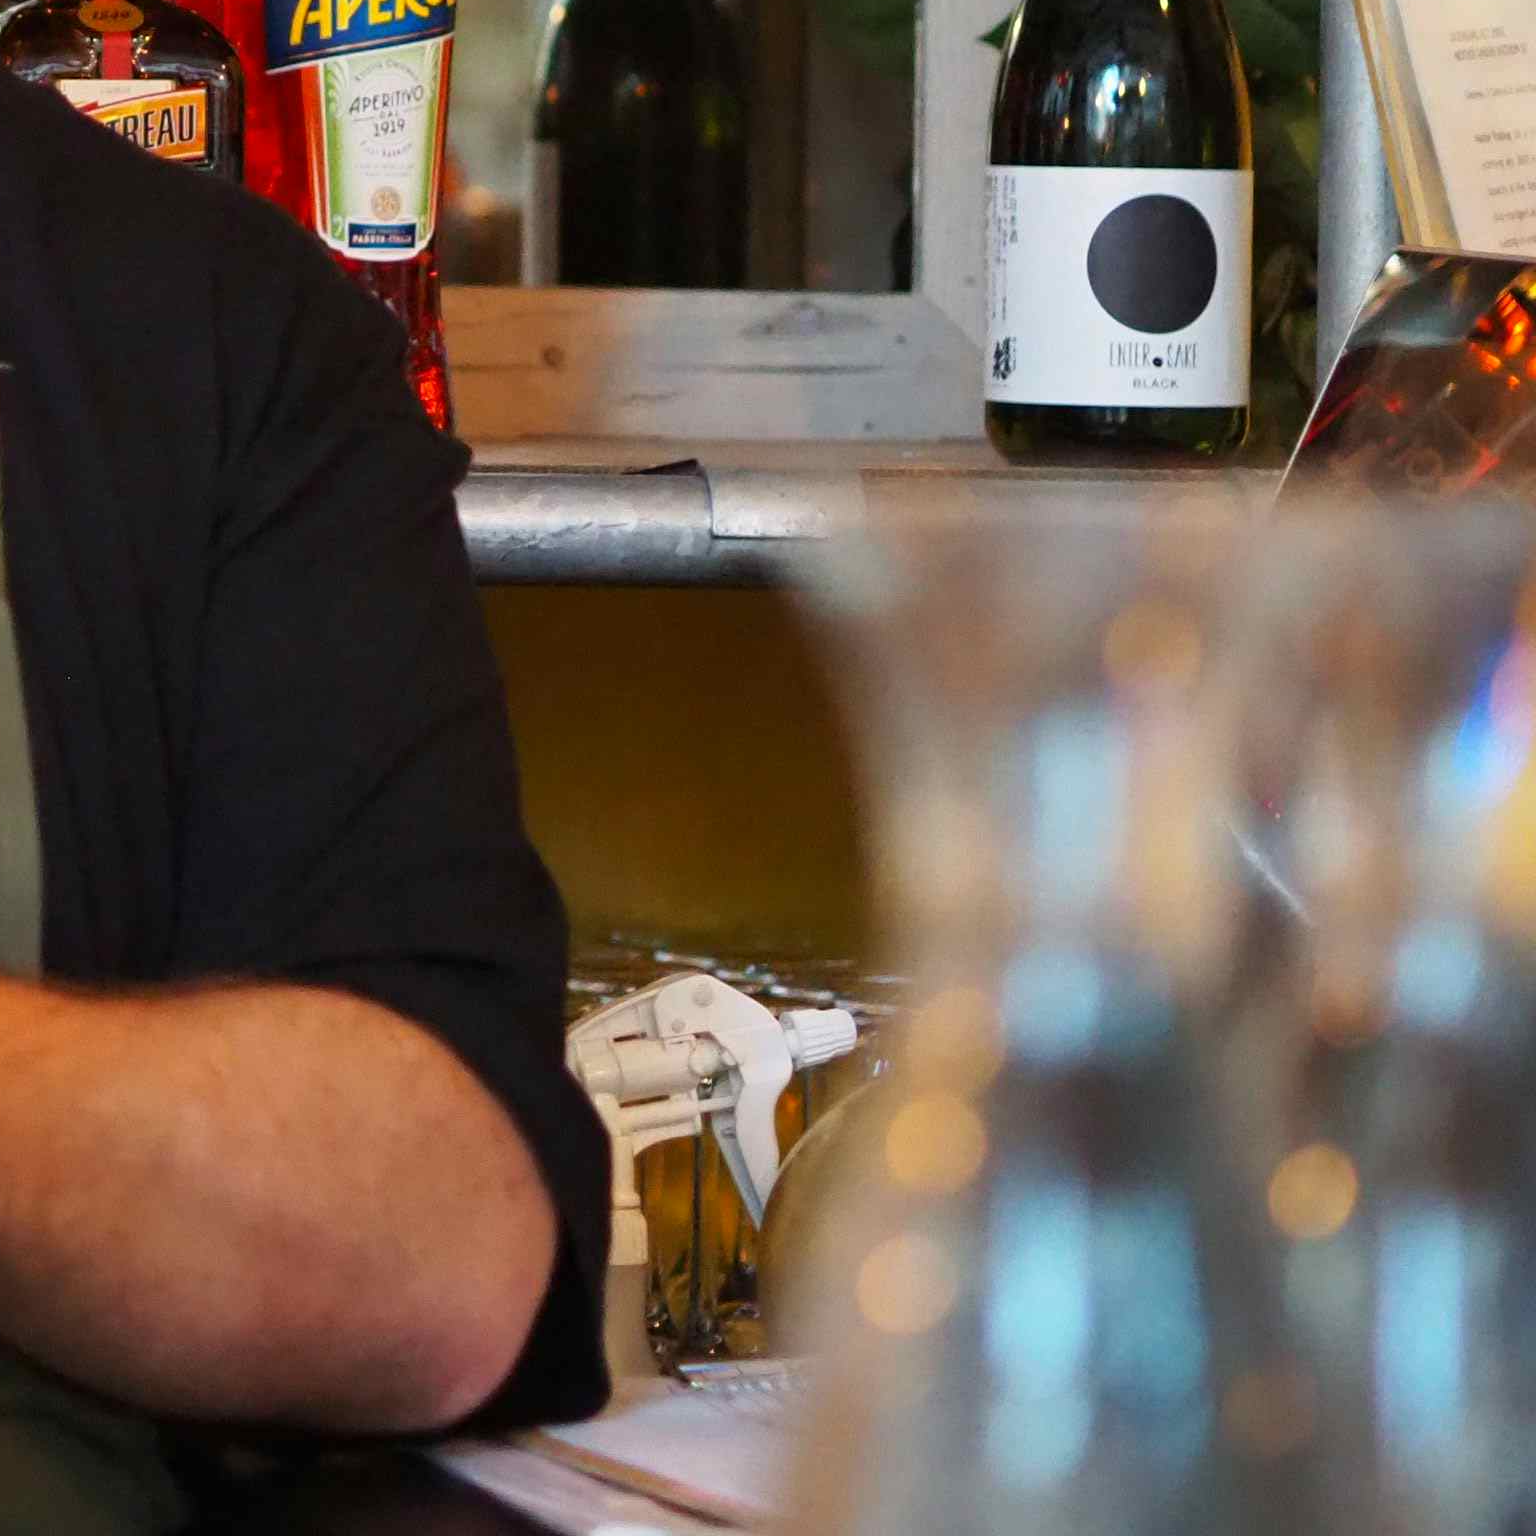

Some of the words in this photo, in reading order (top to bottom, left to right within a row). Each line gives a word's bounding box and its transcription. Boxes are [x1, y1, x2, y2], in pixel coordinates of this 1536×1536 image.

[348, 84, 425, 115] APERITIVO
[373, 119, 406, 138] 1919
[1166, 342, 1200, 369] SAKE
[1132, 377, 1180, 390] BLACK
